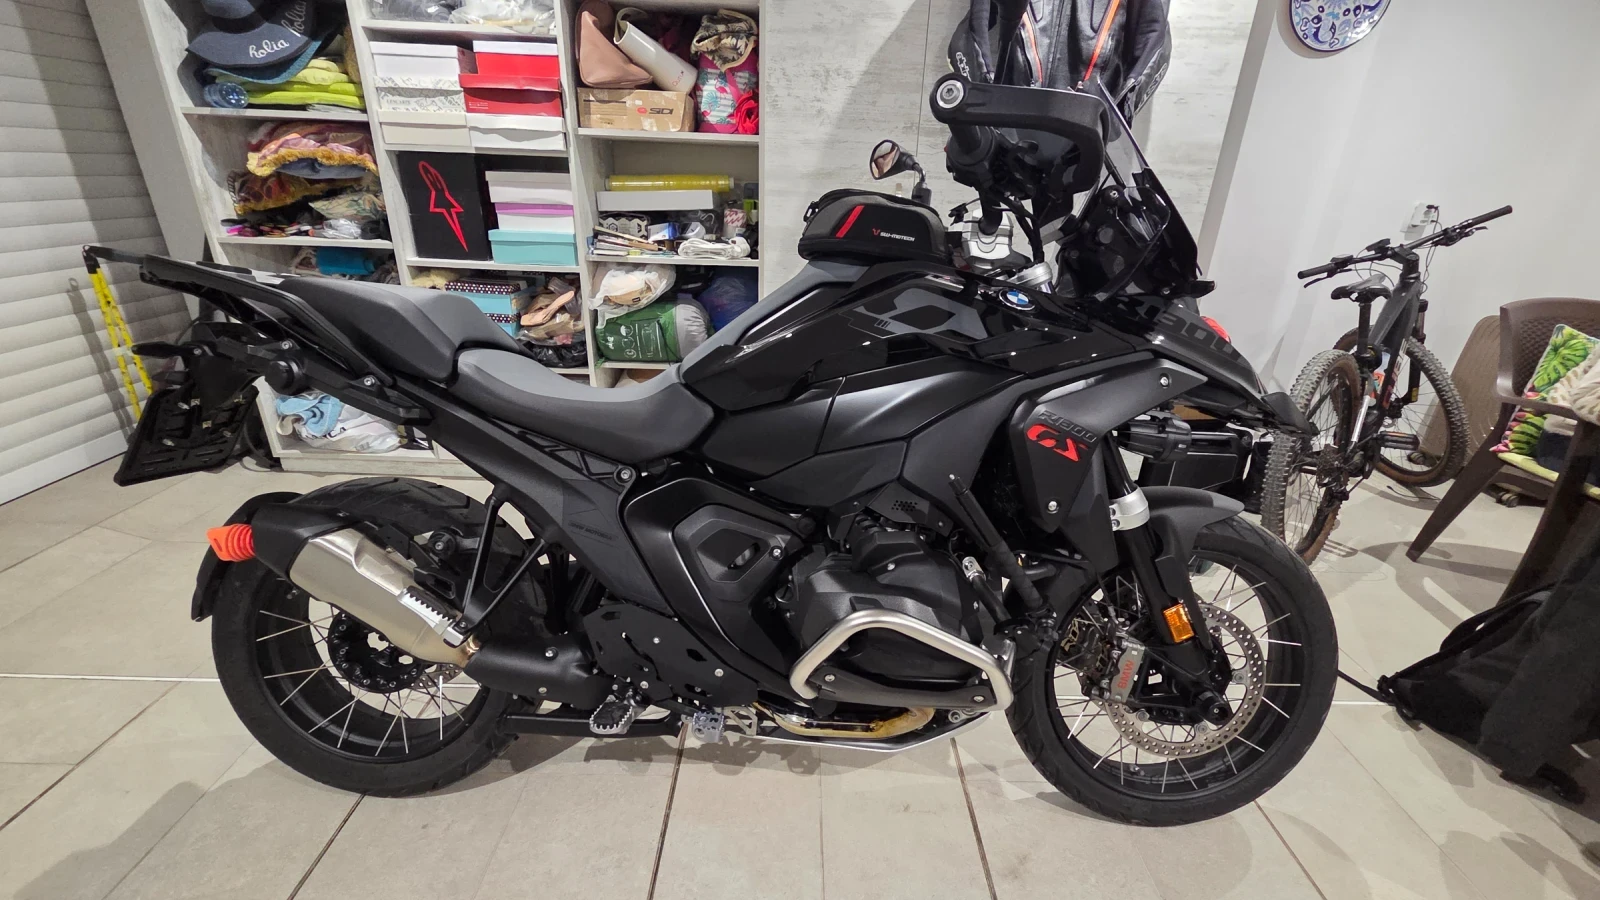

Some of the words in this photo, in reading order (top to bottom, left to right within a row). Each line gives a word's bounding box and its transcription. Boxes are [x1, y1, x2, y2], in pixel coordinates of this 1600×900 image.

[649, 107, 674, 115] SIDI
[1039, 409, 1097, 443] R1300
[1026, 424, 1088, 462] GS
[1117, 660, 1134, 689] BMW
